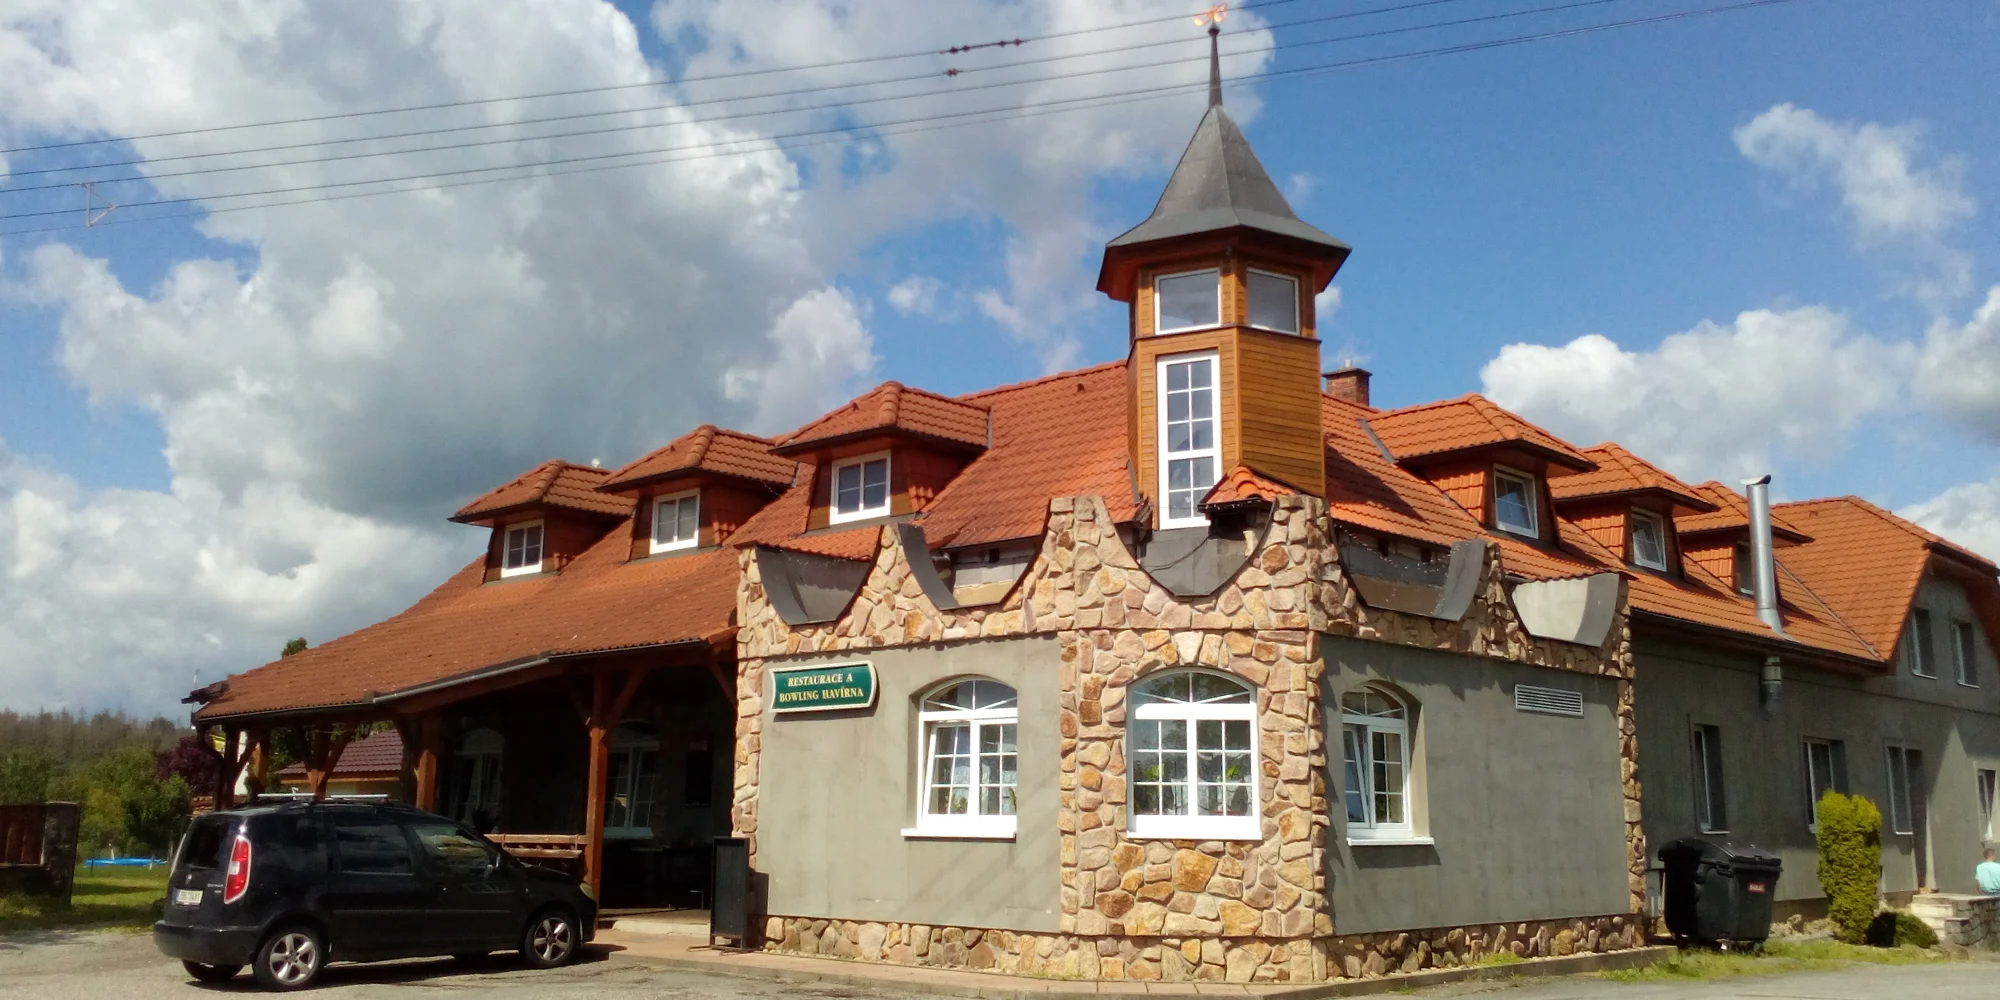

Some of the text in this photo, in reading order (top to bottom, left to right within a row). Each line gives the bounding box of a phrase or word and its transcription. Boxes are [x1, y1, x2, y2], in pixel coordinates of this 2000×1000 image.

[787, 673, 853, 687] RESTAURACE A
[779, 686, 864, 702] BOWLING HAVÍRNA
